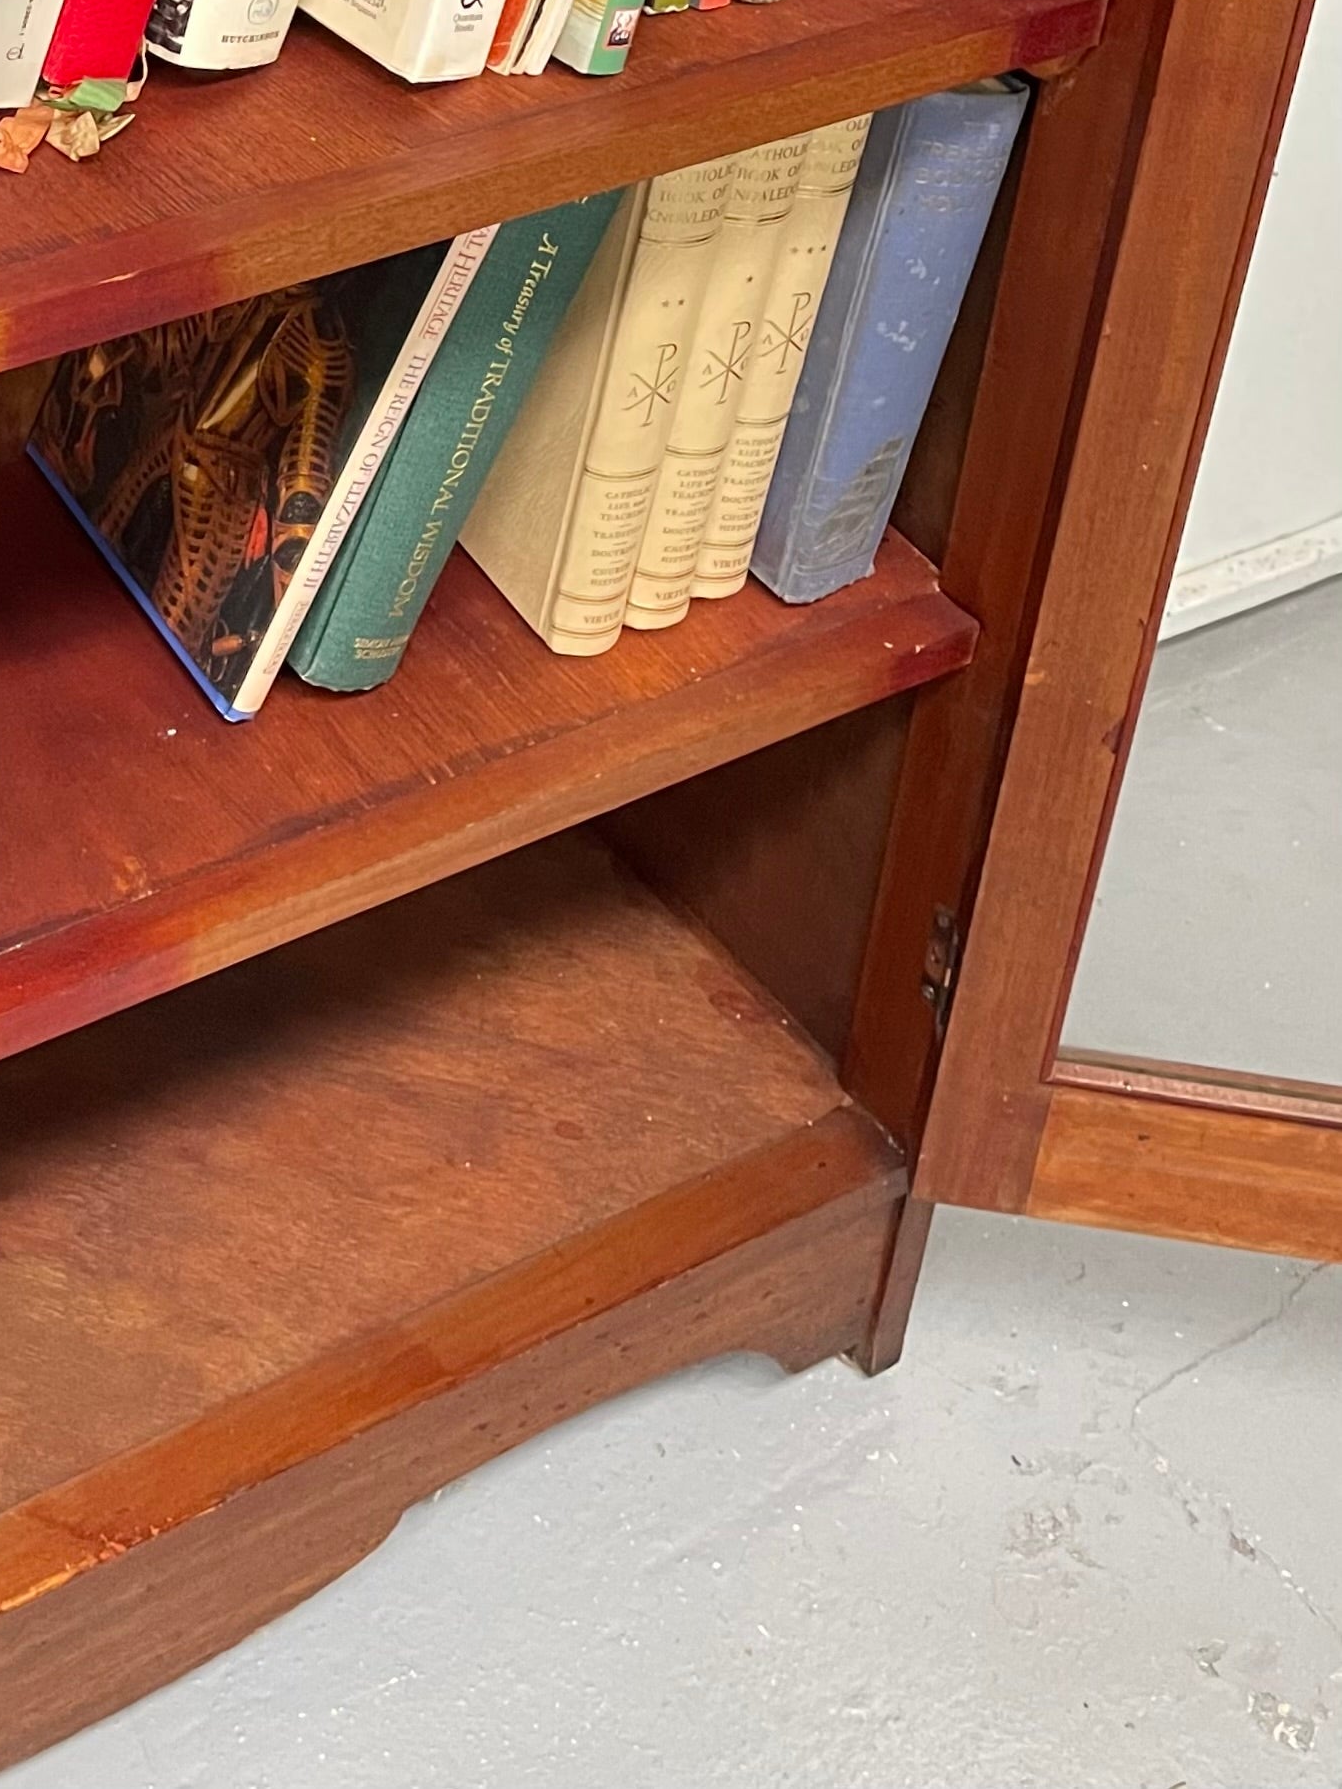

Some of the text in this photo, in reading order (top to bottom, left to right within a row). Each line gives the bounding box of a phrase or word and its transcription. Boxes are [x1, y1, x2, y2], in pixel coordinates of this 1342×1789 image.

[422, 251, 477, 340] HERITAGE
[398, 353, 427, 388] THE
[371, 394, 408, 449] REIGN
[389, 232, 559, 619] A Treasury of TRADITIONAL WISDOM
[359, 453, 379, 473] OF
[311, 481, 366, 572] ELIZABETH
